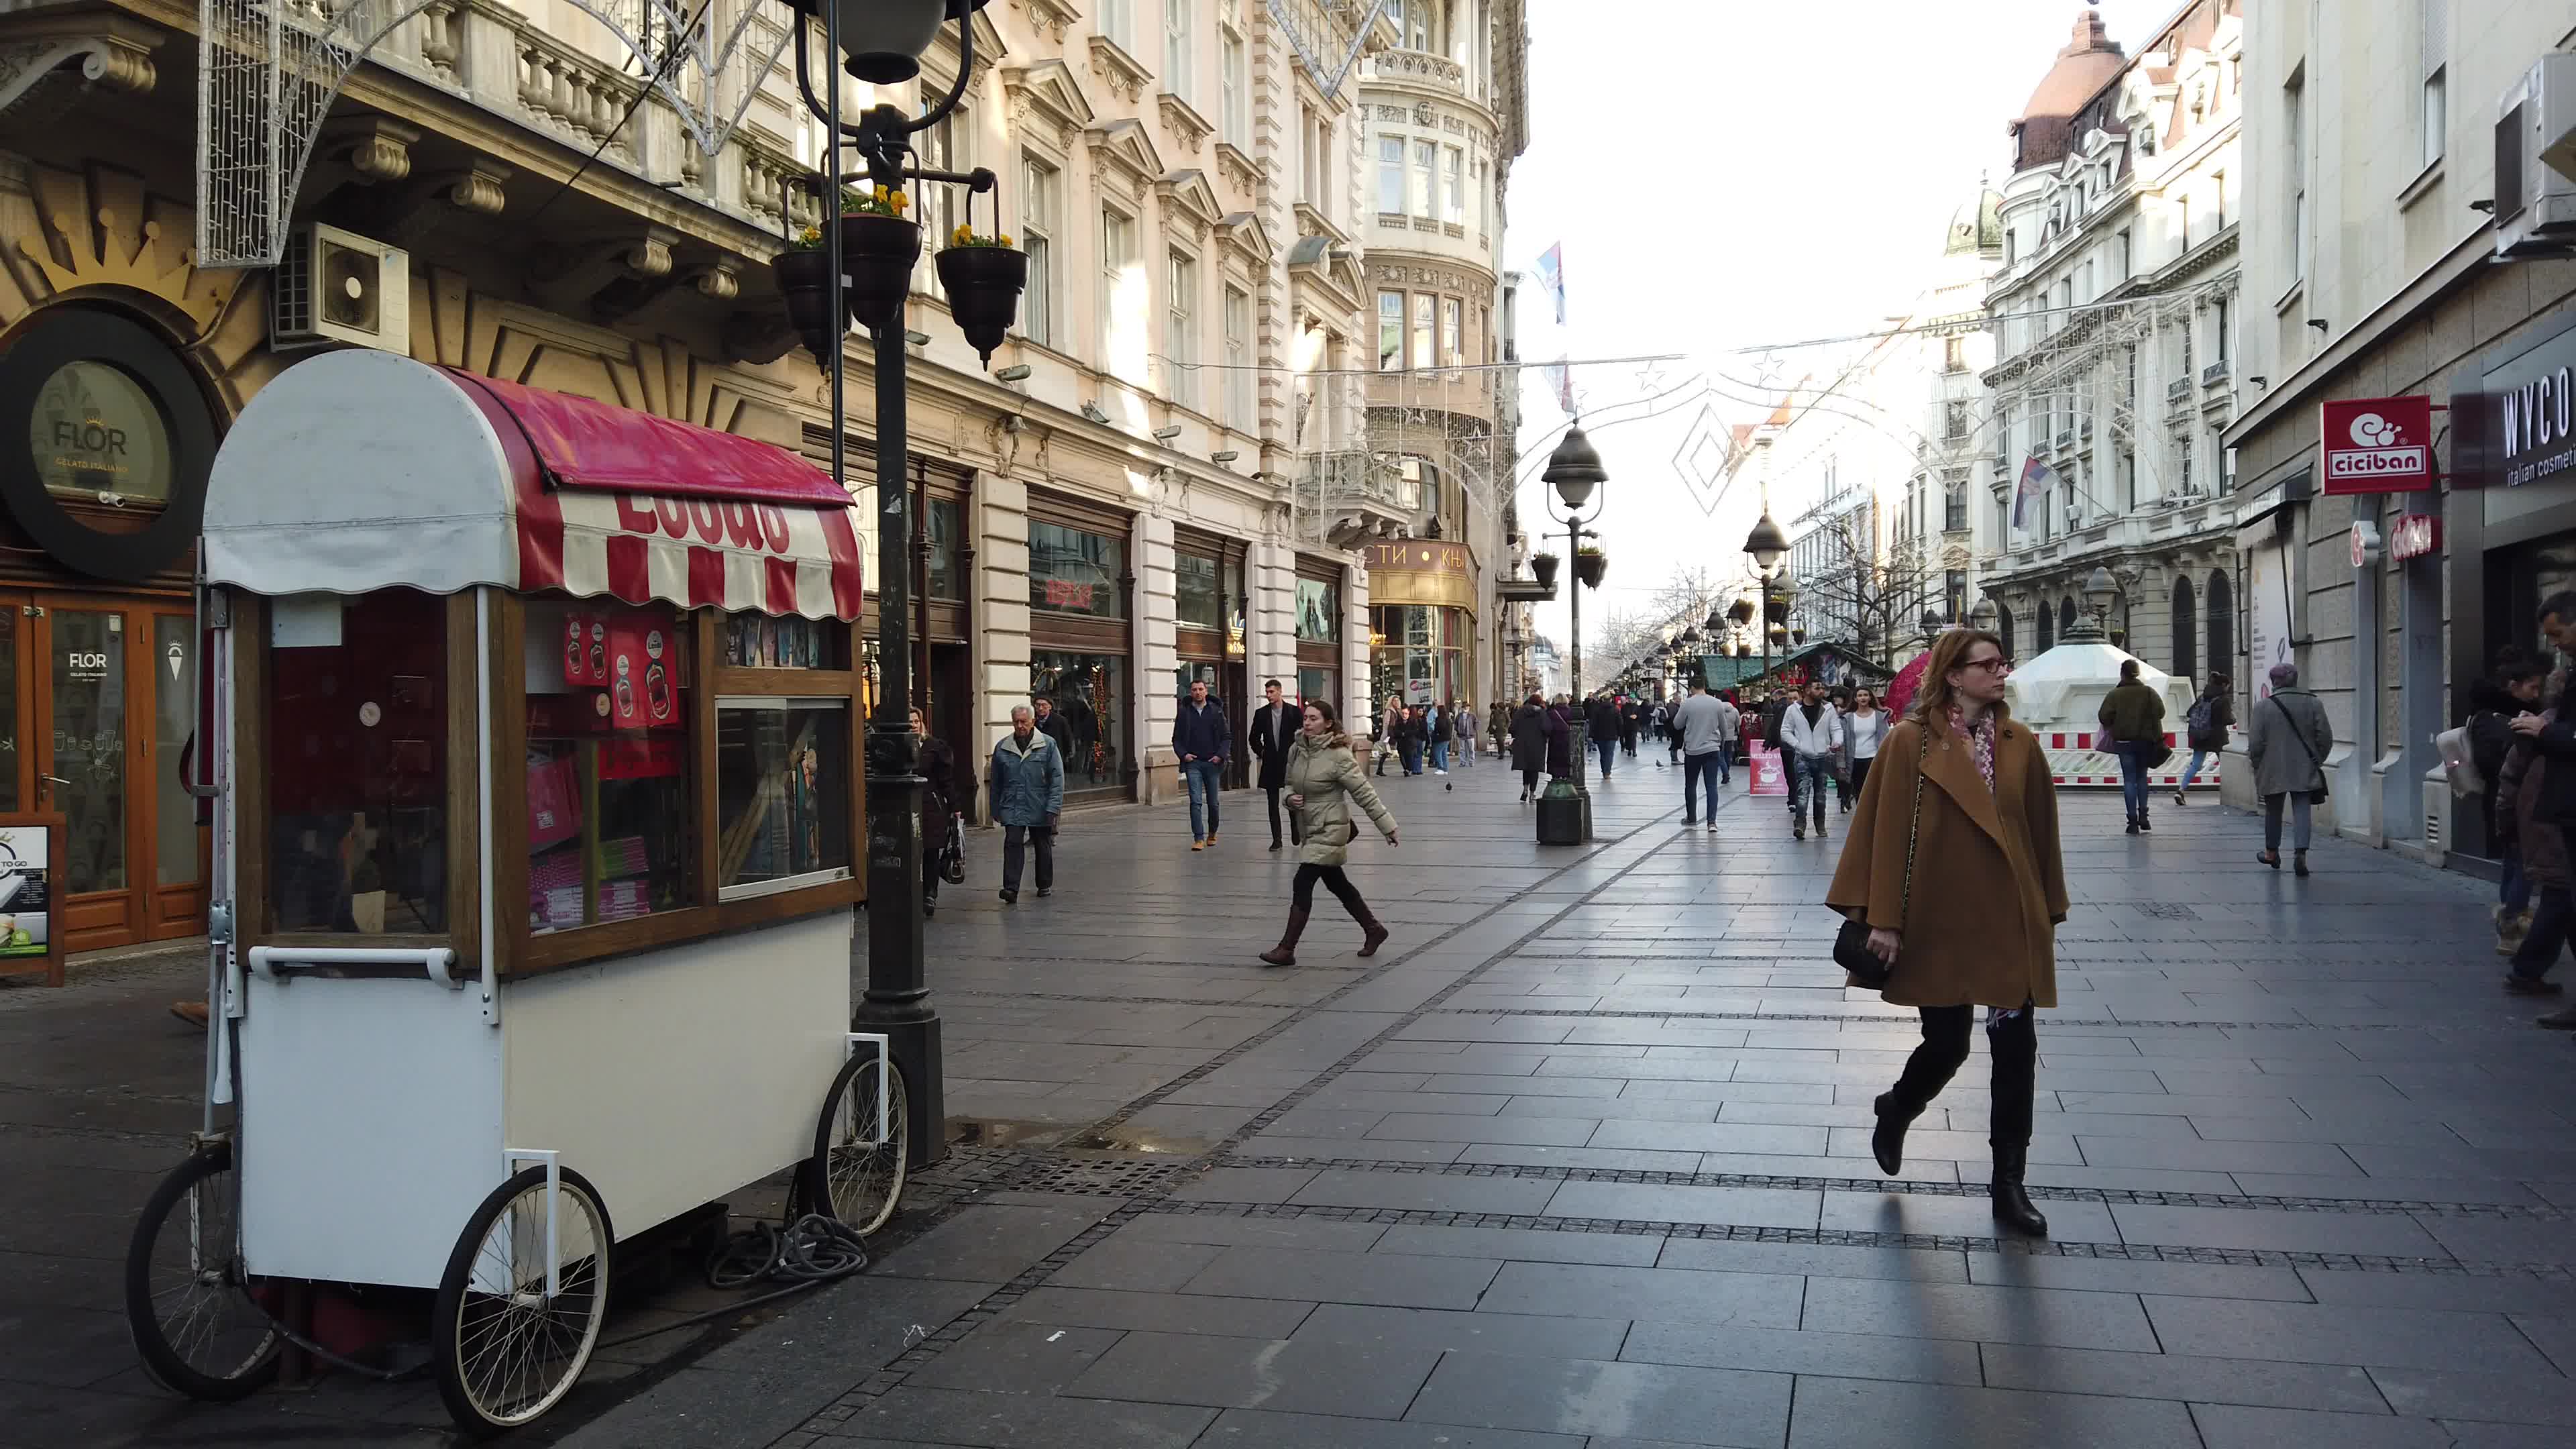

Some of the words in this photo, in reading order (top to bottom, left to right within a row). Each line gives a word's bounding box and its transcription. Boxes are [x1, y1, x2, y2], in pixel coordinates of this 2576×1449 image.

[2504, 366, 2569, 458] WYCO
[54, 421, 127, 455] FLOR
[2335, 454, 2417, 472] ciciban
[2508, 463, 2534, 488] italian
[70, 653, 107, 667] FLOR
